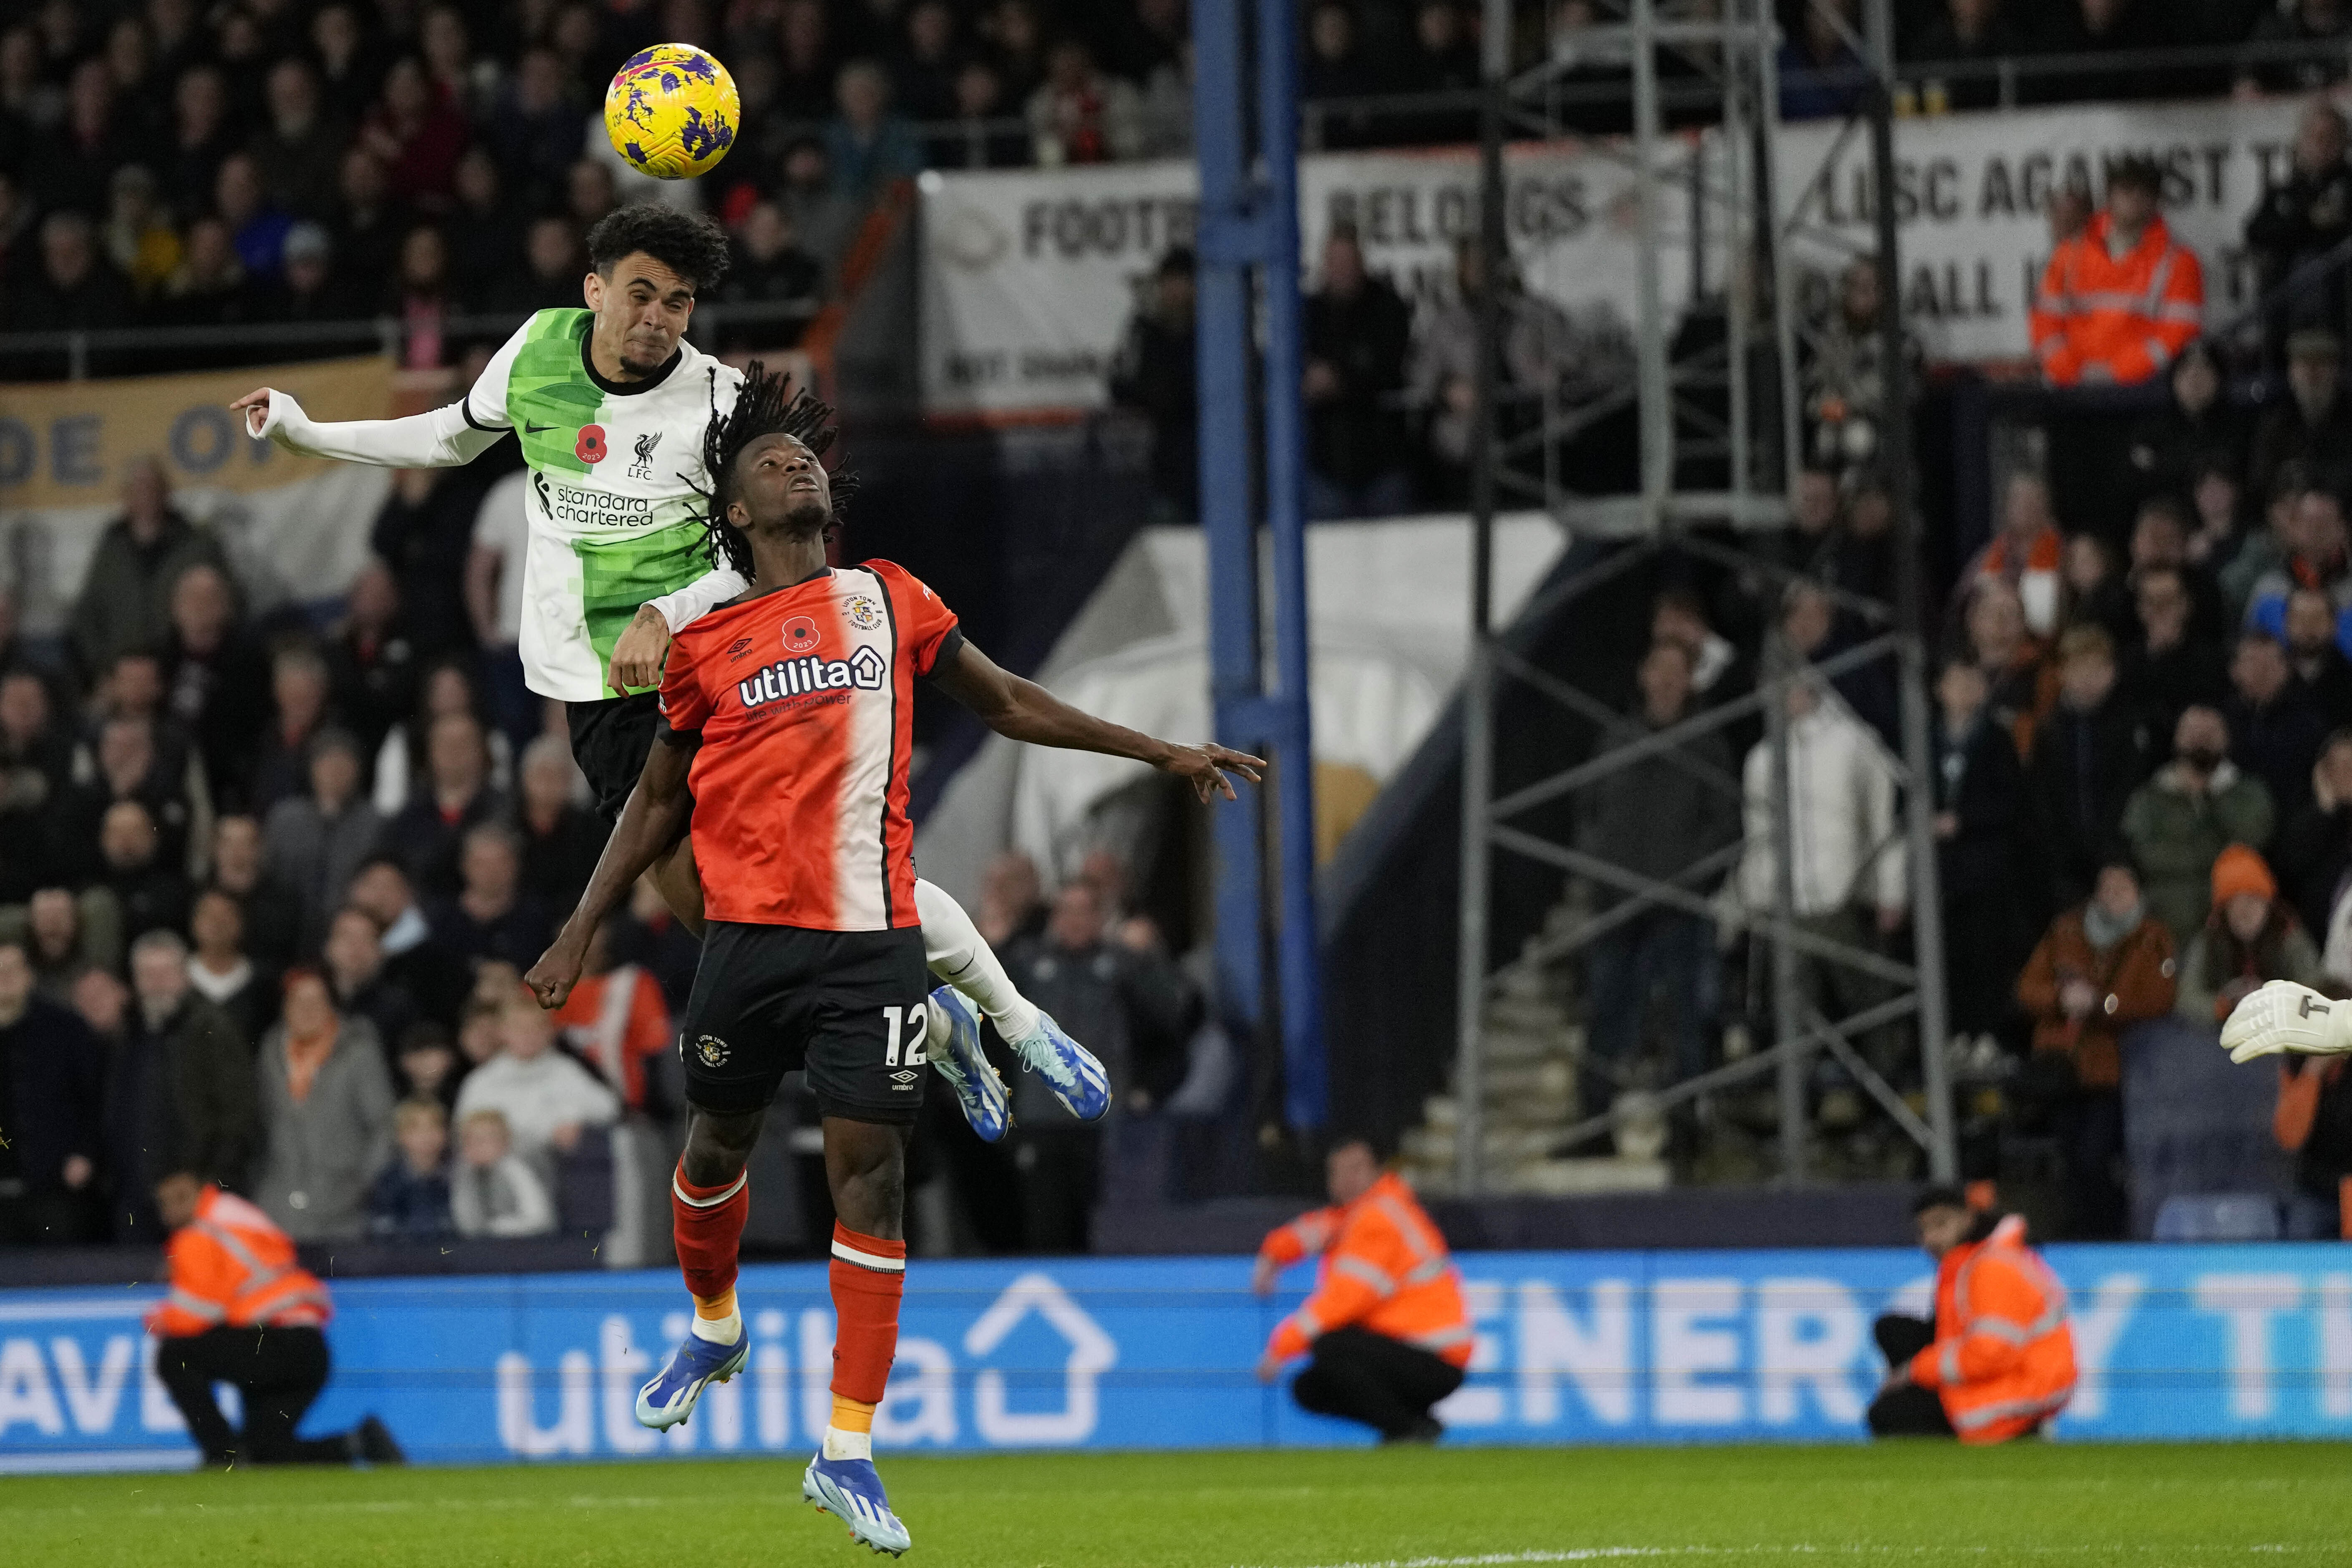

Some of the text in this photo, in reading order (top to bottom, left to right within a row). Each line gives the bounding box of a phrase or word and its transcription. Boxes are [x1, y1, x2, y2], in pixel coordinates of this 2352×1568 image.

[558, 486, 648, 512] standard
[557, 504, 653, 527] chartered
[842, 595, 877, 608] LUTON TOWN
[848, 618, 882, 631] FOOTBALL CLUB
[793, 639, 813, 648] 2023
[730, 648, 753, 663] umbro
[740, 656, 852, 706] utilita
[745, 709, 767, 723] life
[771, 699, 800, 715] with
[883, 1002, 928, 1066] 12
